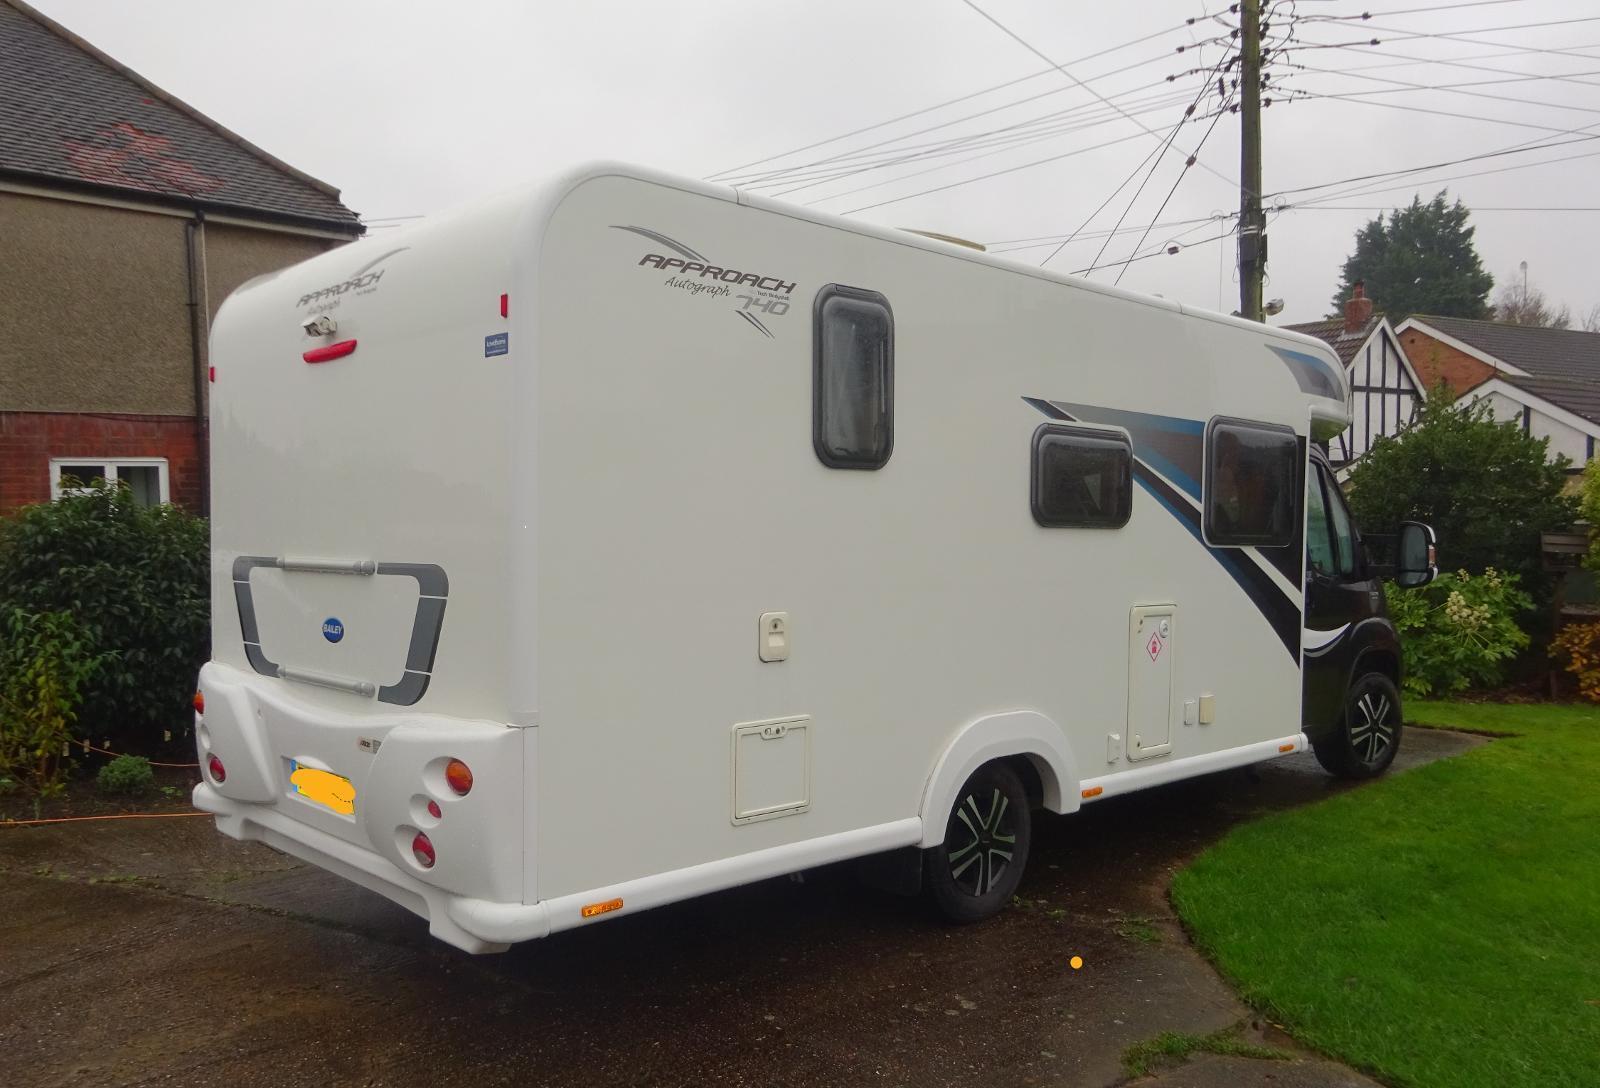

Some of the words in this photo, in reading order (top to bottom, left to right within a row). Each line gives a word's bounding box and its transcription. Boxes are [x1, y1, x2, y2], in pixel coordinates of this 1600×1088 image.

[638, 254, 797, 294] APPROACH
[664, 276, 731, 298] Autograph
[735, 295, 790, 315] 740
[323, 623, 342, 635] BAILEY
